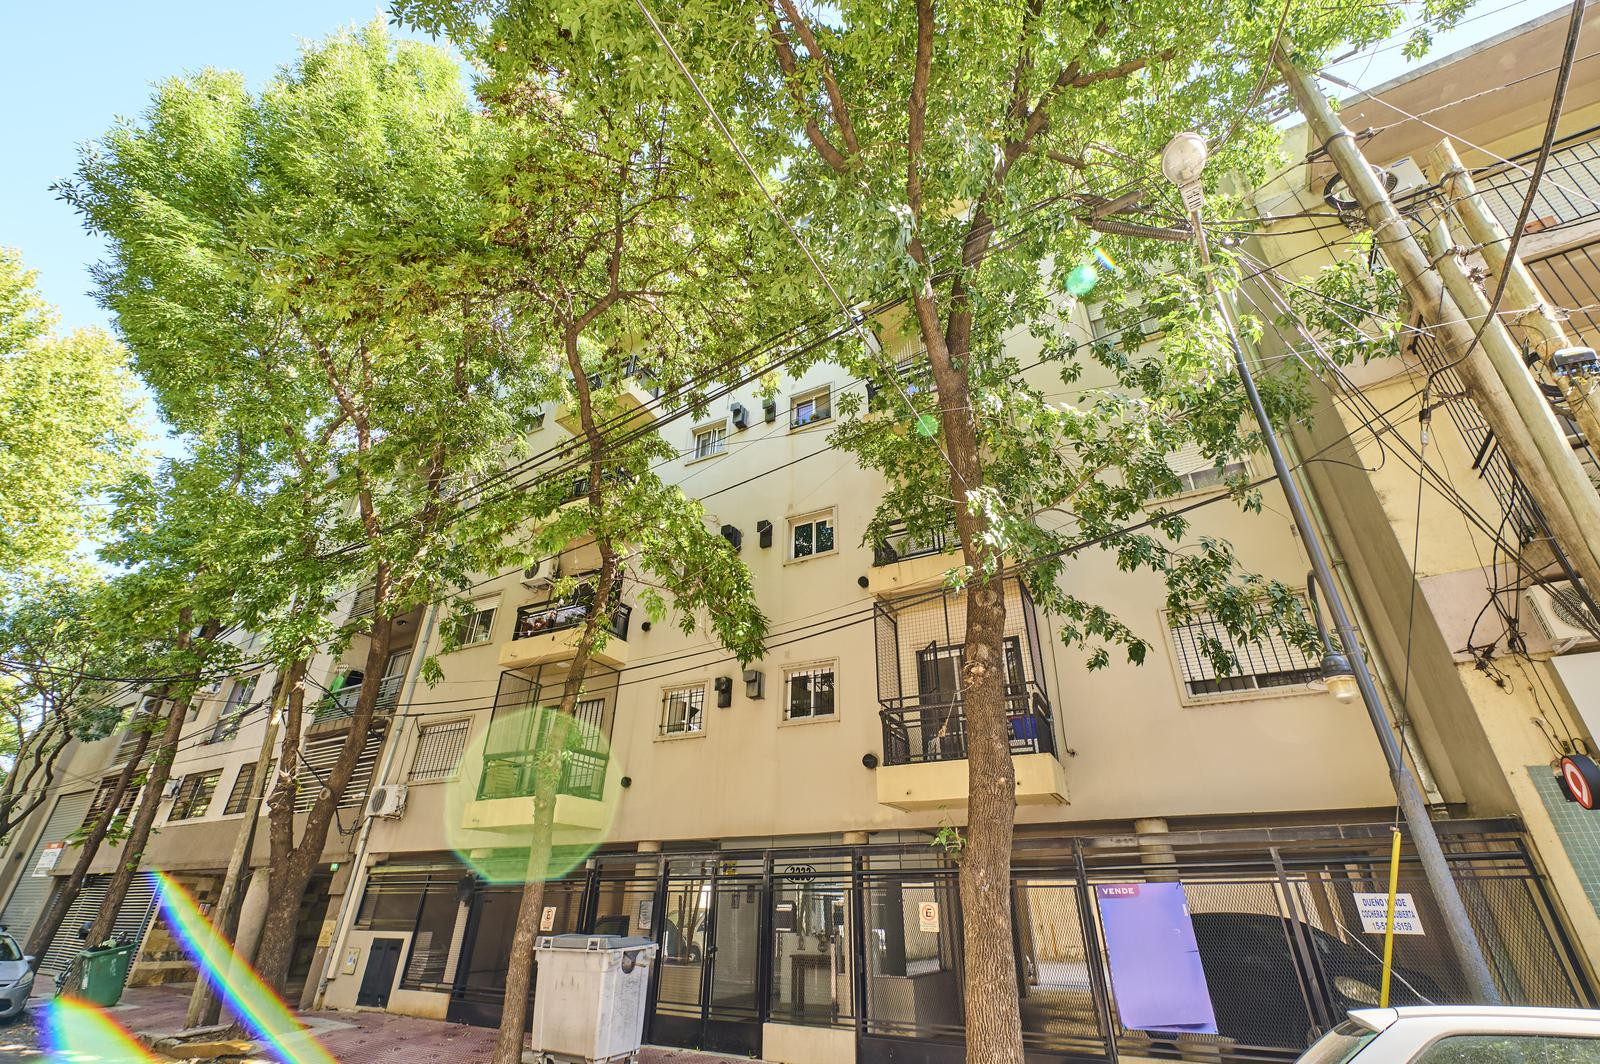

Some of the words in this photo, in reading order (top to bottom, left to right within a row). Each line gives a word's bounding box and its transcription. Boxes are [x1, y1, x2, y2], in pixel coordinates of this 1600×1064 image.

[1102, 887, 1135, 895] VENDE
[1384, 898, 1407, 907] VNDE
[1361, 910, 1383, 918] COCHERA
